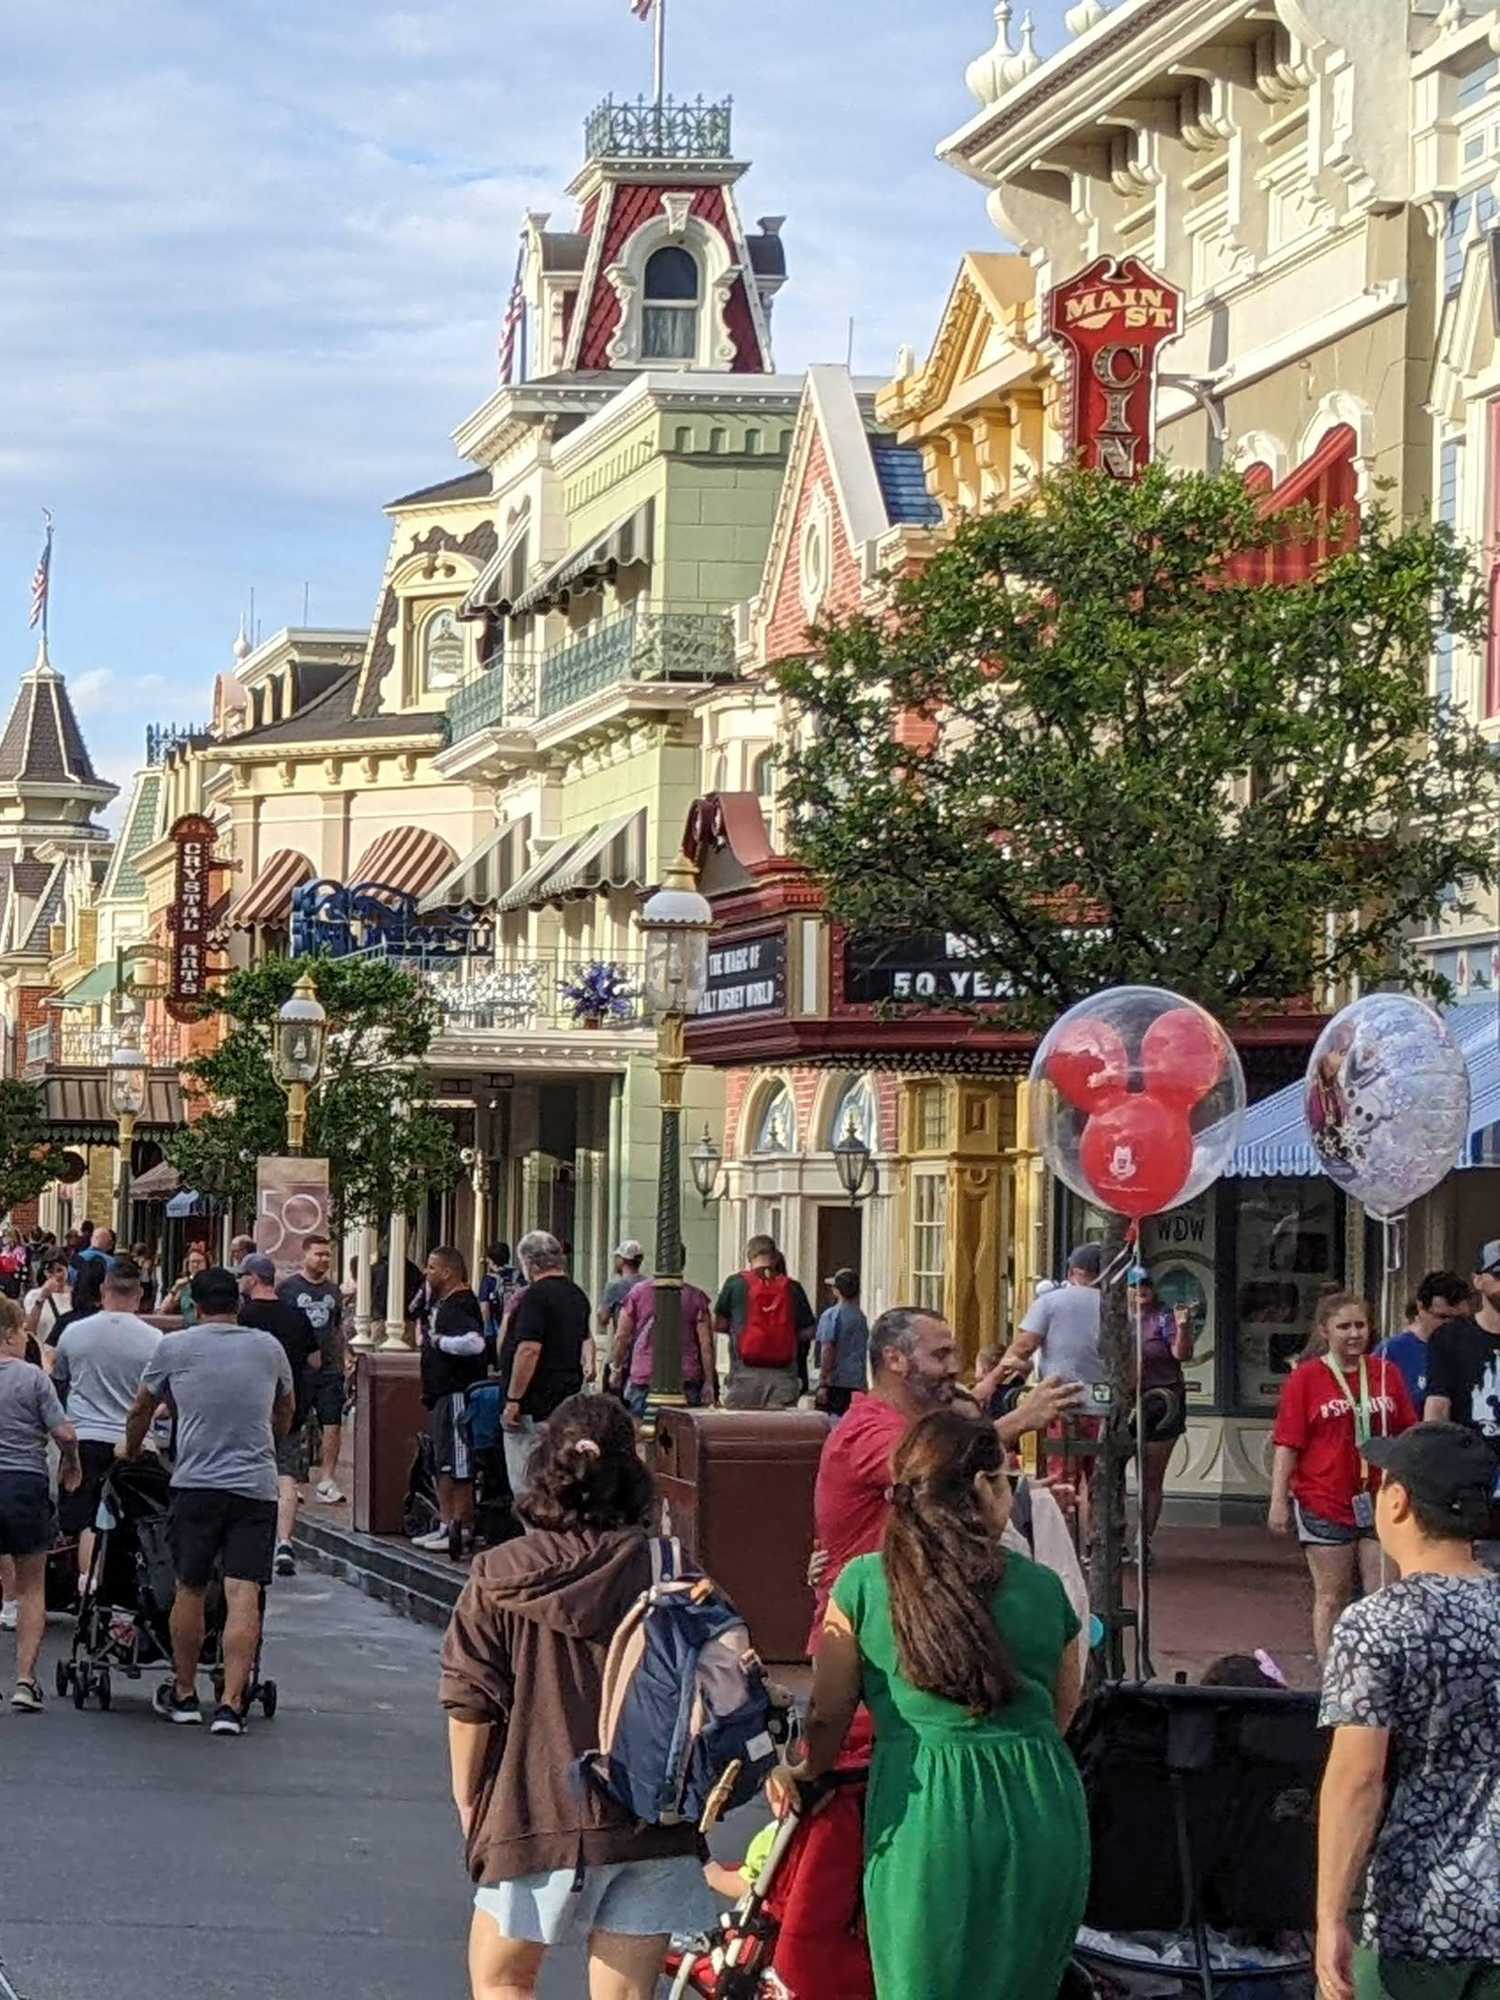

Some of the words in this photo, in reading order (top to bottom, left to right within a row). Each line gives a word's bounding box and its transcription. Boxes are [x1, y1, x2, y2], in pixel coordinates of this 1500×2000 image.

[1064, 288, 1165, 322] MAIN
[1124, 307, 1174, 329] ST.
[1092, 343, 1143, 479] CIN
[182, 842, 203, 931] CRYSTAL
[179, 944, 200, 995] ARTS
[893, 971, 936, 998] 50
[261, 1189, 323, 1255] 50
